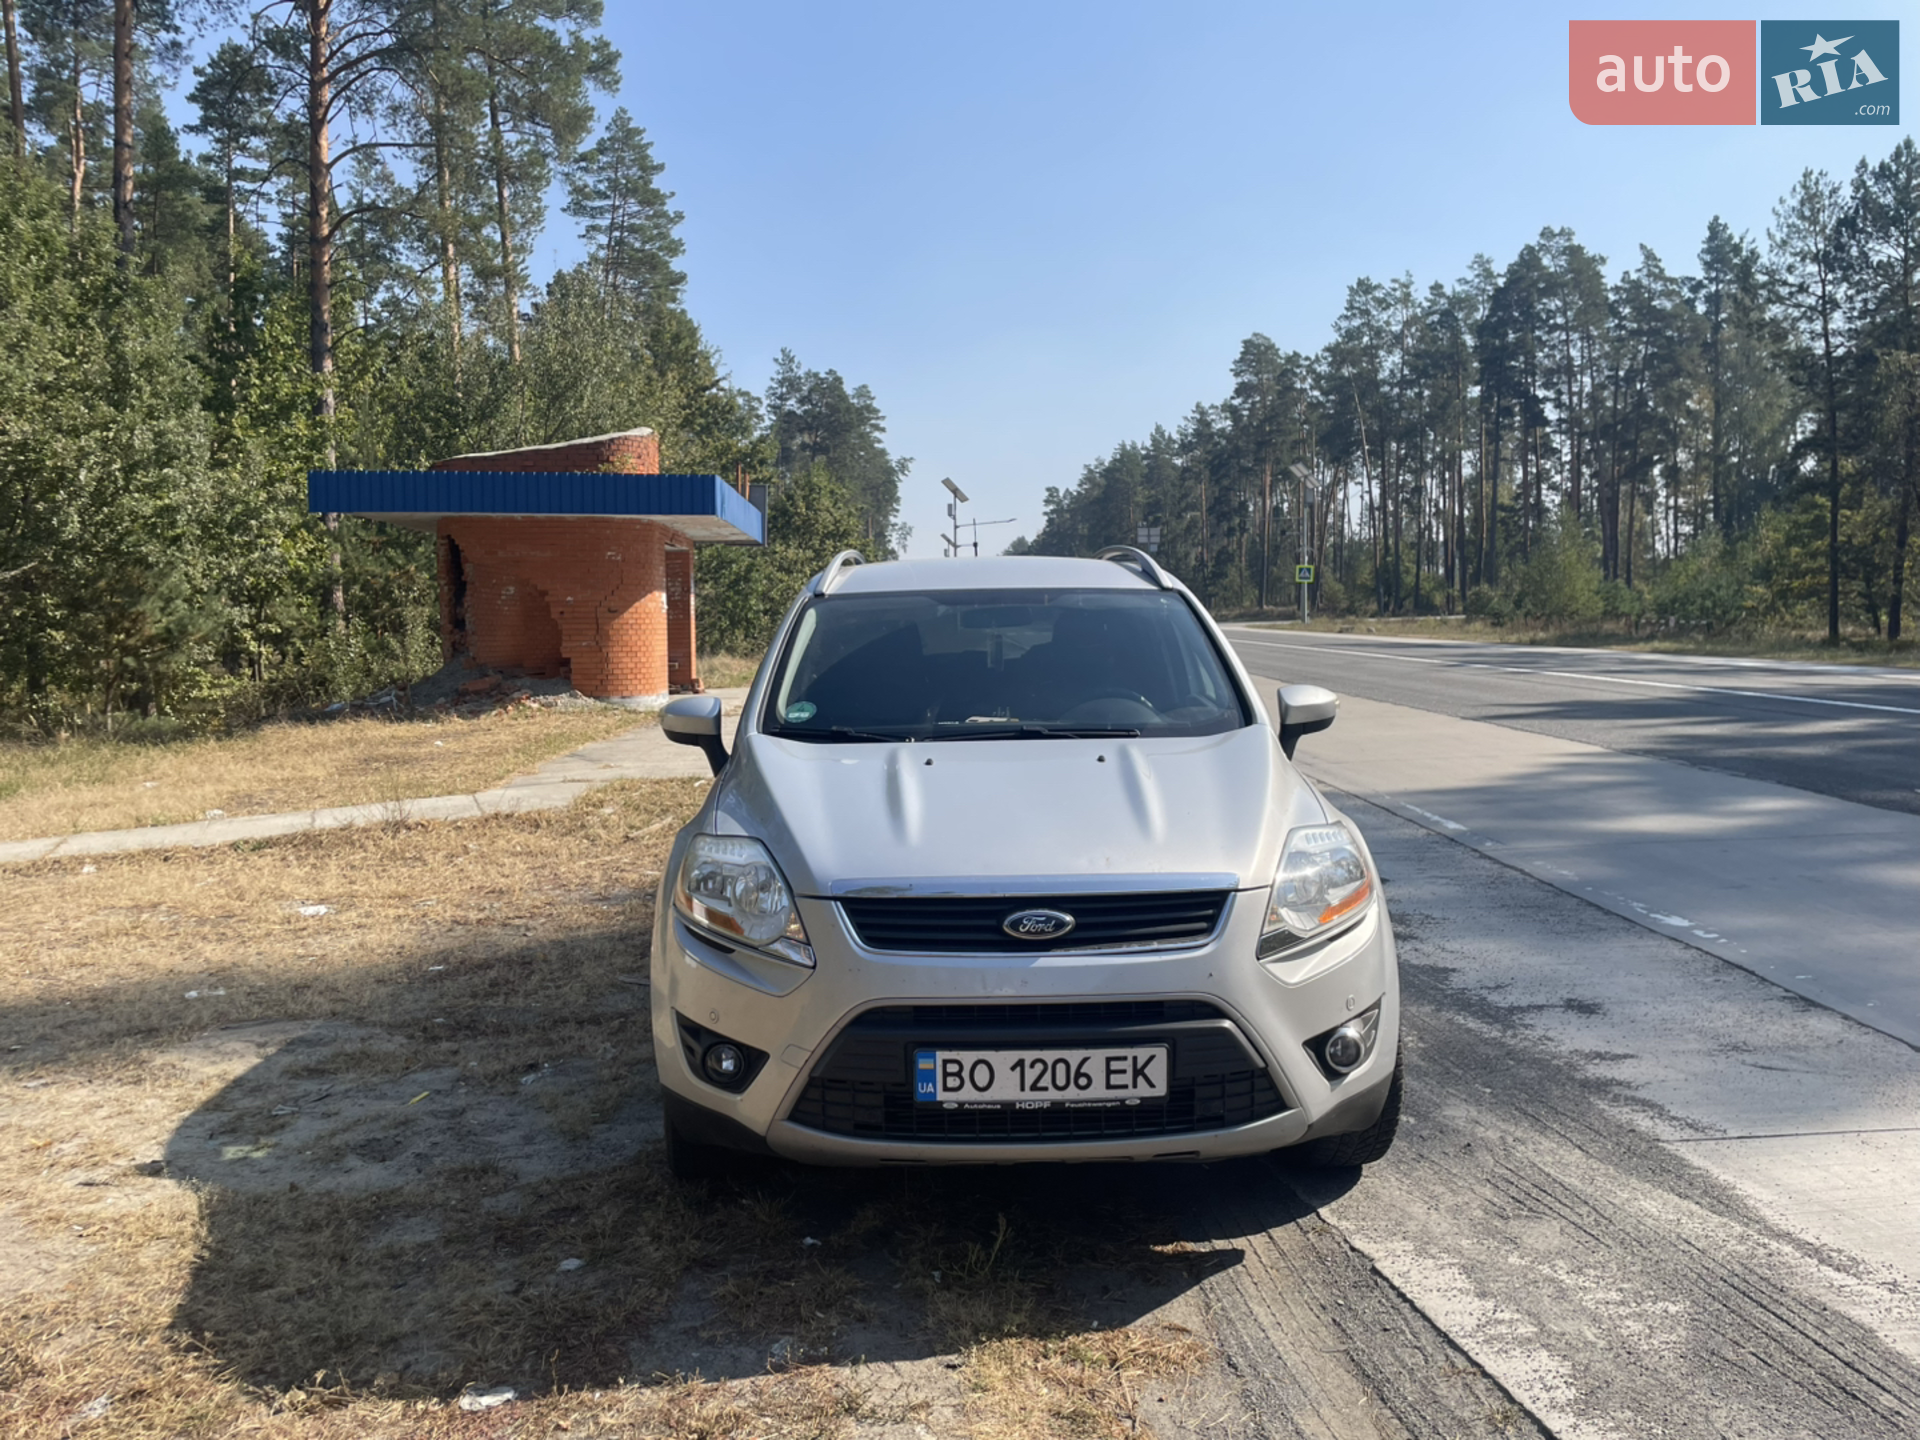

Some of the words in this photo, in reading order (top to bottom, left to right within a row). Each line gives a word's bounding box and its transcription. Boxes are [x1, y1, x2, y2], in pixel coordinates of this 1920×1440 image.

[1019, 916, 1056, 932] Ford
[942, 1058, 995, 1093] BO
[1009, 1056, 1093, 1092] 1206
[1105, 1054, 1157, 1090] EK
[918, 1082, 935, 1094] UA
[1015, 1101, 1052, 1110] HOPF
